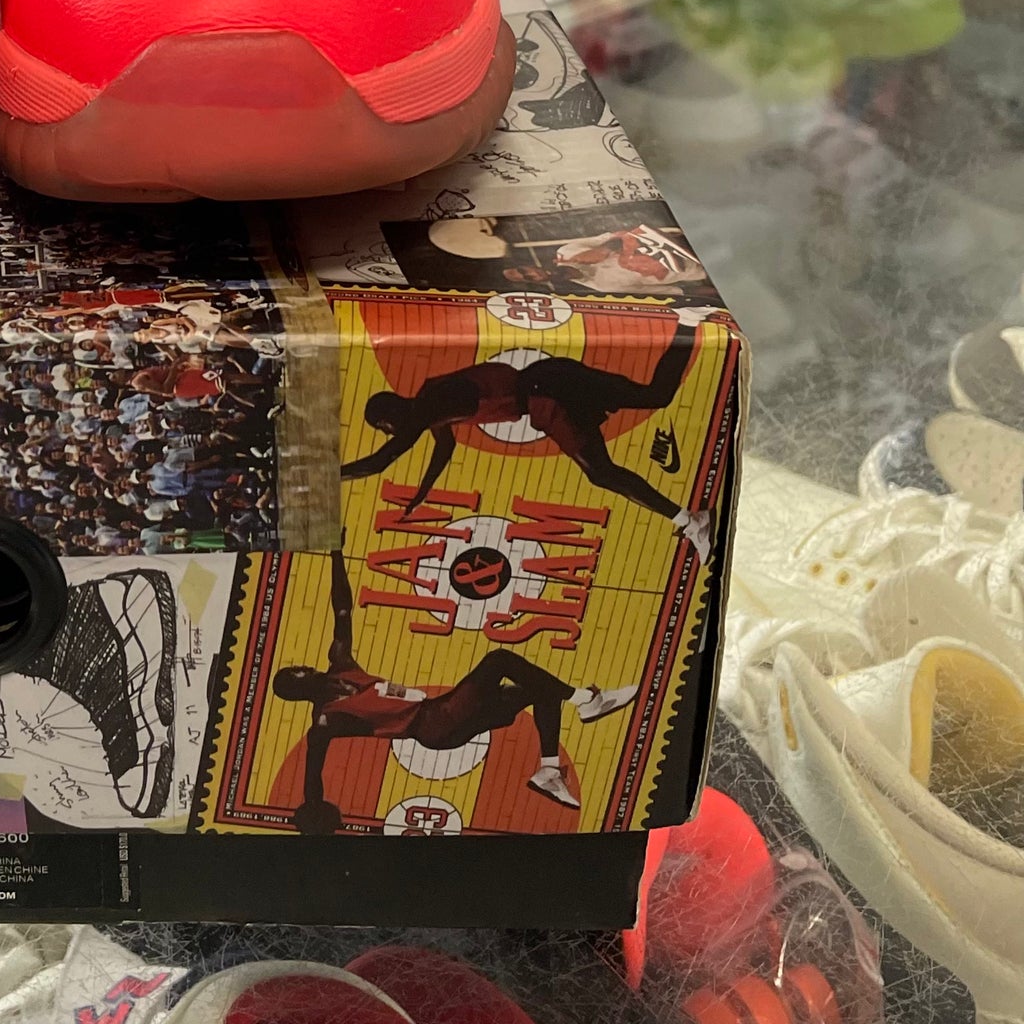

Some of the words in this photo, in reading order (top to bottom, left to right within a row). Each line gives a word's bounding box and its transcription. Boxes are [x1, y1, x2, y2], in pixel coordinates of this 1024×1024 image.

[505, 295, 555, 323] 23
[719, 408, 732, 433] STAR
[649, 427, 674, 465] NIKE
[712, 438, 725, 465] TEAM
[703, 470, 717, 499] EVERY
[359, 478, 482, 637] JAM
[681, 556, 694, 582] YEAR
[453, 553, 506, 596] &
[483, 494, 612, 651] SLAM
[266, 587, 275, 601] US
[260, 605, 271, 627] 1984
[257, 631, 266, 649] THE
[657, 631, 673, 667] LEAGUE
[245, 666, 259, 704] MEMBER
[653, 669, 664, 691] MVP
[643, 699, 655, 718] ALL
[241, 715, 250, 735] WAS
[638, 720, 649, 741] NBA
[234, 736, 246, 771] JORDAN
[630, 743, 643, 768] FIRST
[225, 772, 239, 811] MICHAEL
[623, 769, 636, 794] TEAM
[13, 865, 49, 874] CHINE
